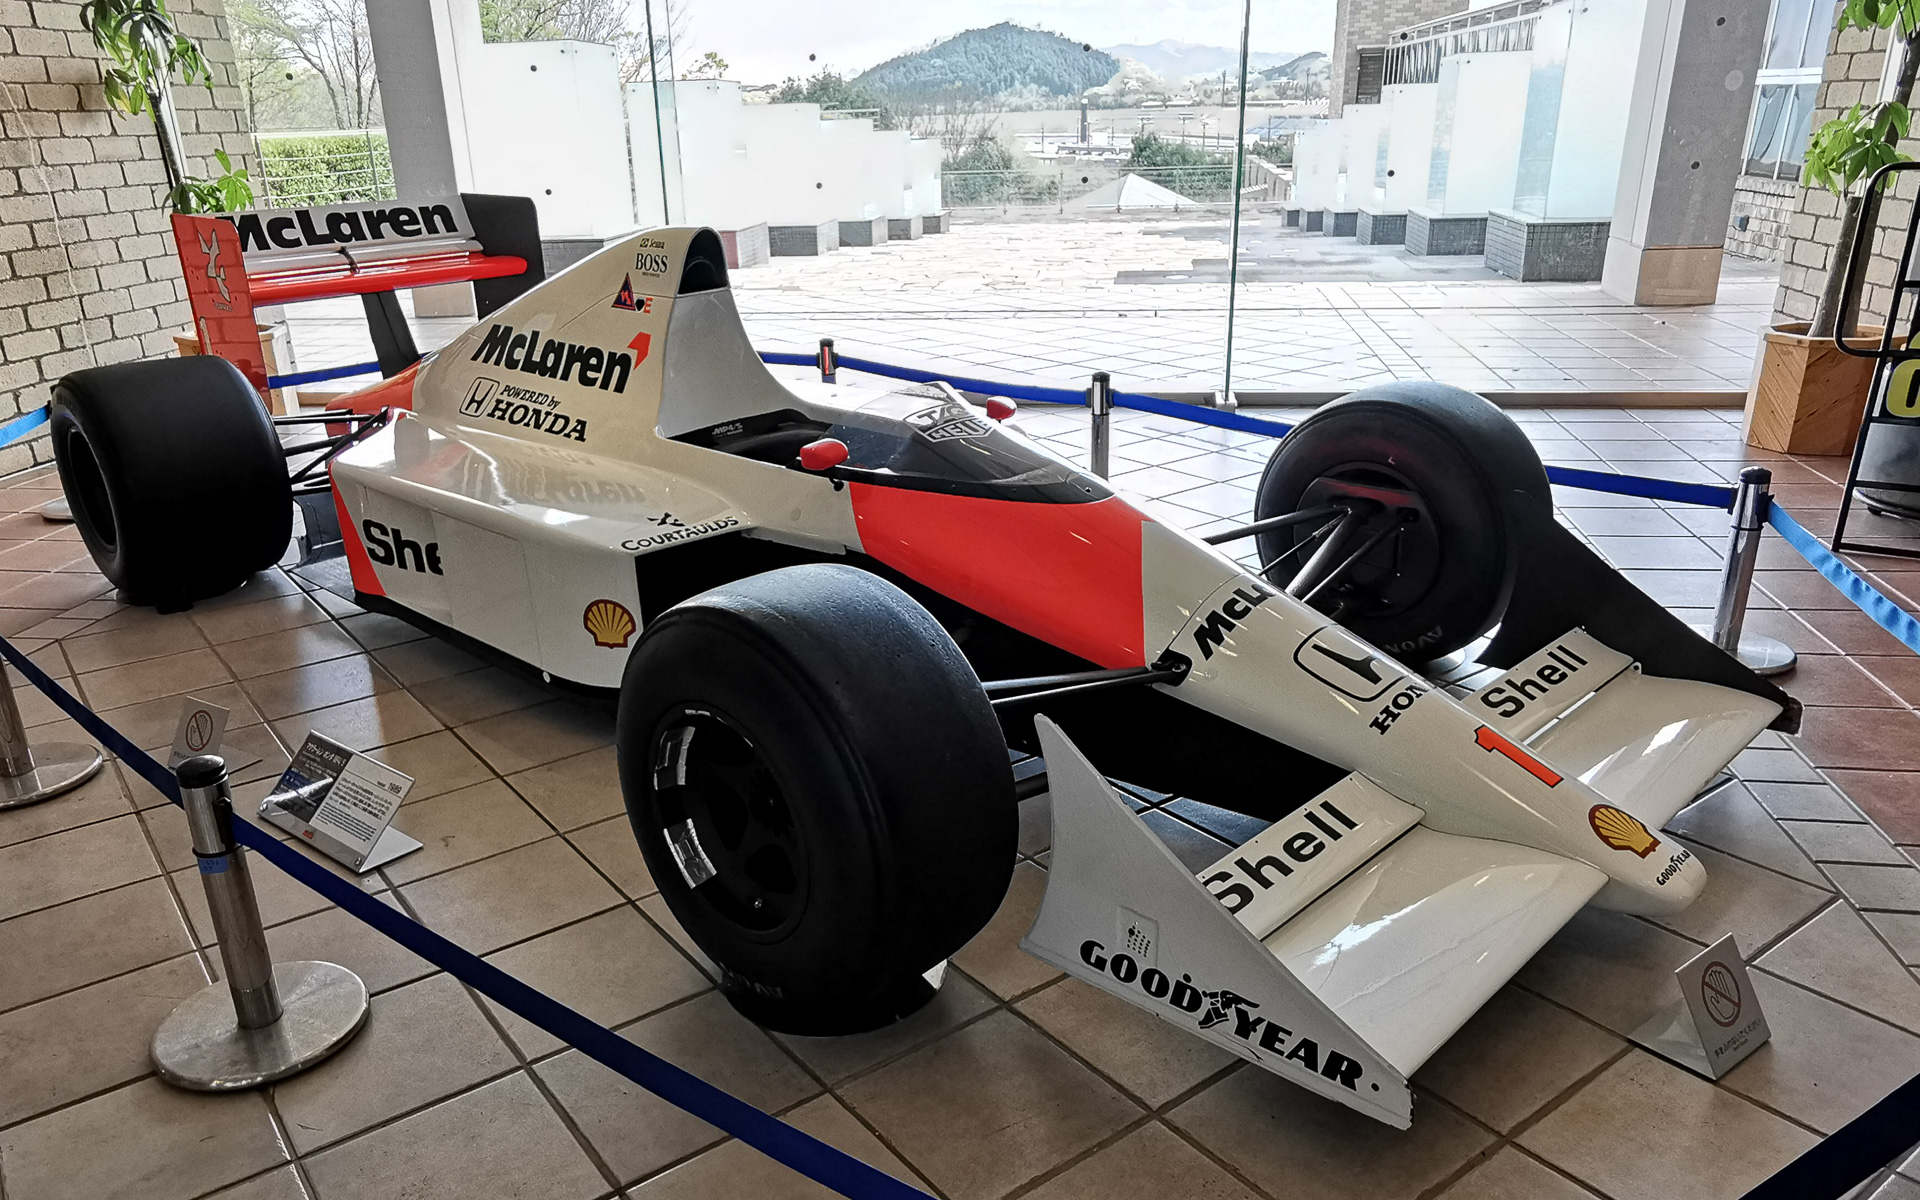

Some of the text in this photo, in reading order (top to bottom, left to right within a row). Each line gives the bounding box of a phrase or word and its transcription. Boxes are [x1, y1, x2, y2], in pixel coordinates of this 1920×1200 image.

[215, 203, 458, 253] McLaren
[635, 252, 668, 274] BOSS
[470, 323, 632, 394] McLaren
[487, 398, 588, 442] HONDA
[500, 384, 562, 410] POWERED by
[620, 516, 739, 551] COURTAULDS
[1384, 625, 1443, 653] AVON
[1480, 644, 1589, 719] Shell
[1474, 724, 1564, 789] 1
[1202, 800, 1359, 915] Shell
